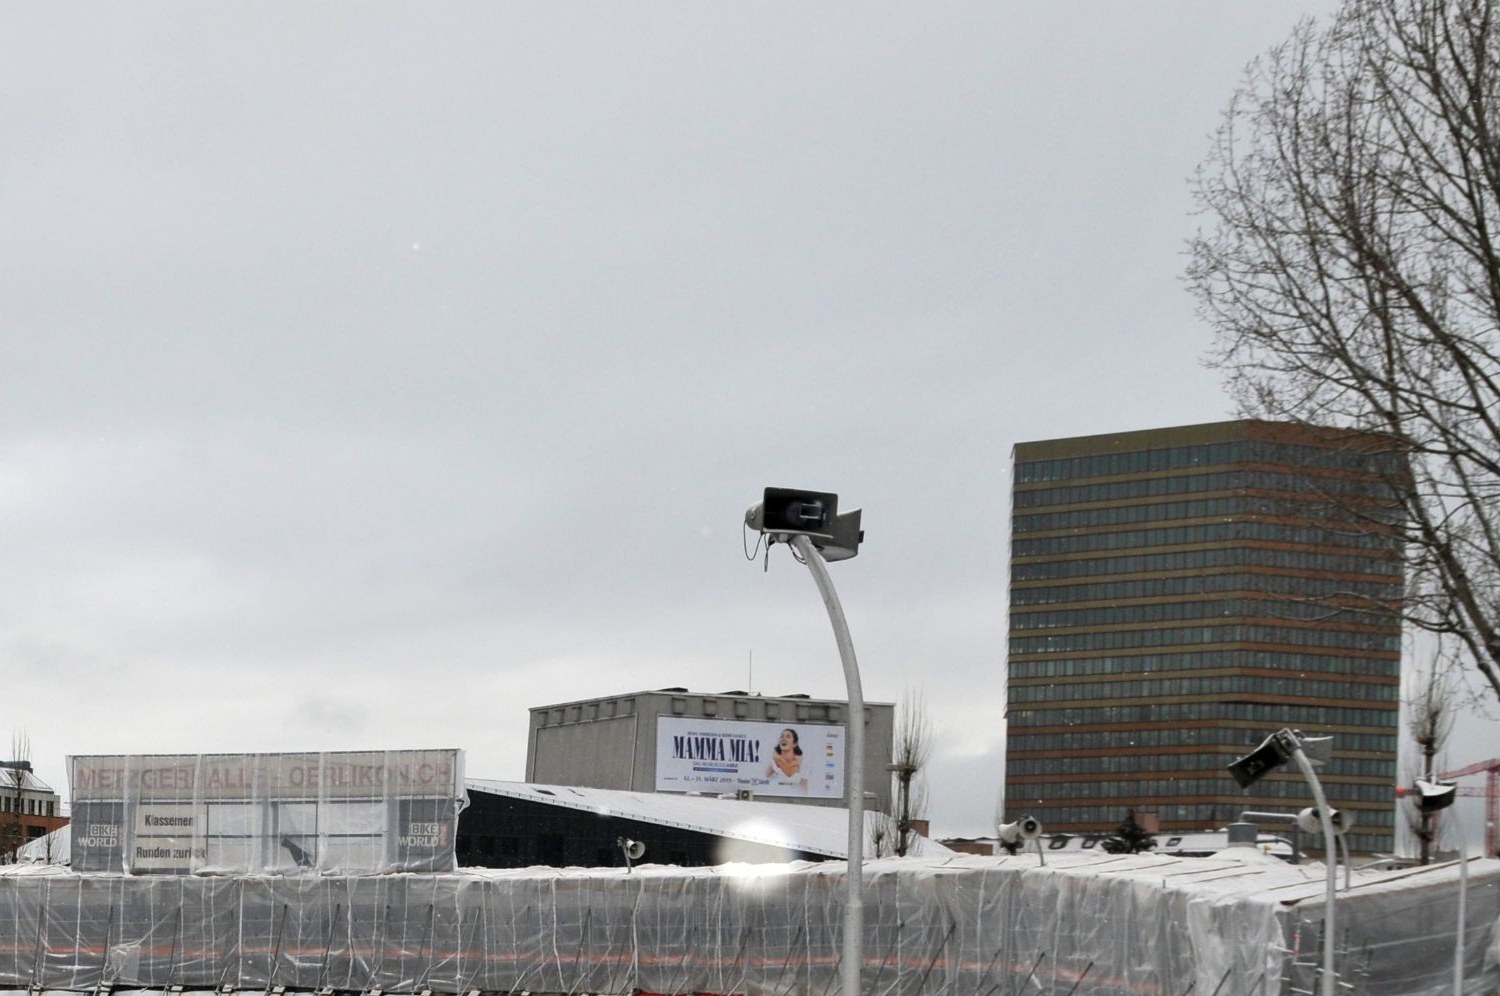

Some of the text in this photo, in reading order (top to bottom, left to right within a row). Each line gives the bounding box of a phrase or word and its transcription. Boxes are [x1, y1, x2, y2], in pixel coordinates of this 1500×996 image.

[672, 736, 760, 763] MAMMA MIA!
[91, 825, 117, 835] BIKE
[412, 824, 438, 834] BIKE
[77, 837, 117, 847] WORLD
[398, 836, 439, 847] WORLD
[136, 847, 171, 858] Runden
